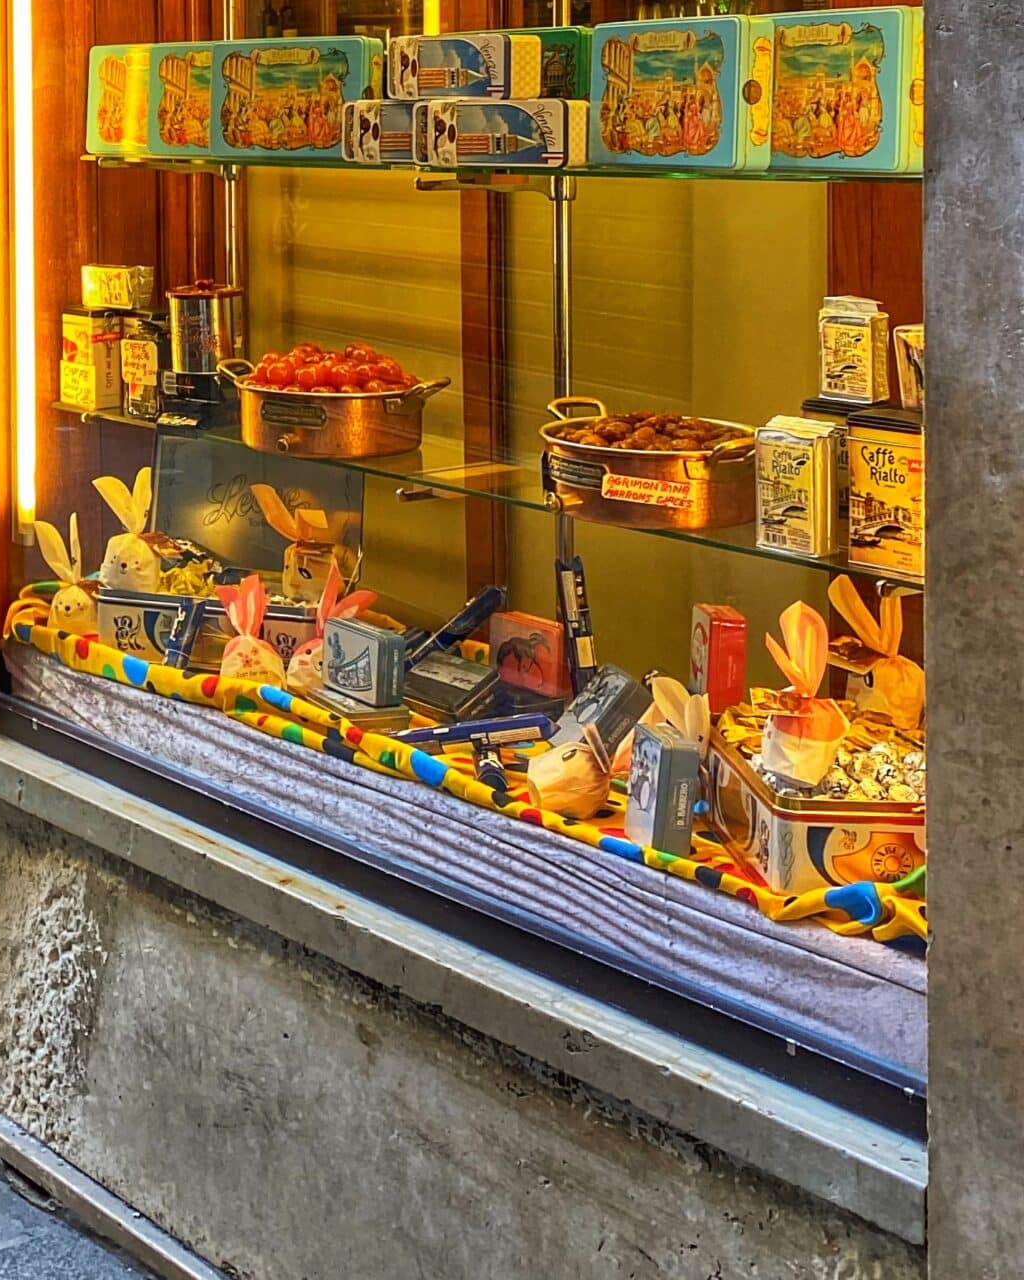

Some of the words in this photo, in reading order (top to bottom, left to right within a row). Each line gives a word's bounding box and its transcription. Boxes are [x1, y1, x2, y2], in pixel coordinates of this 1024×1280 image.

[860, 445, 896, 468] Caffé
[771, 459, 801, 478] Rialto
[869, 466, 906, 486] Rialto
